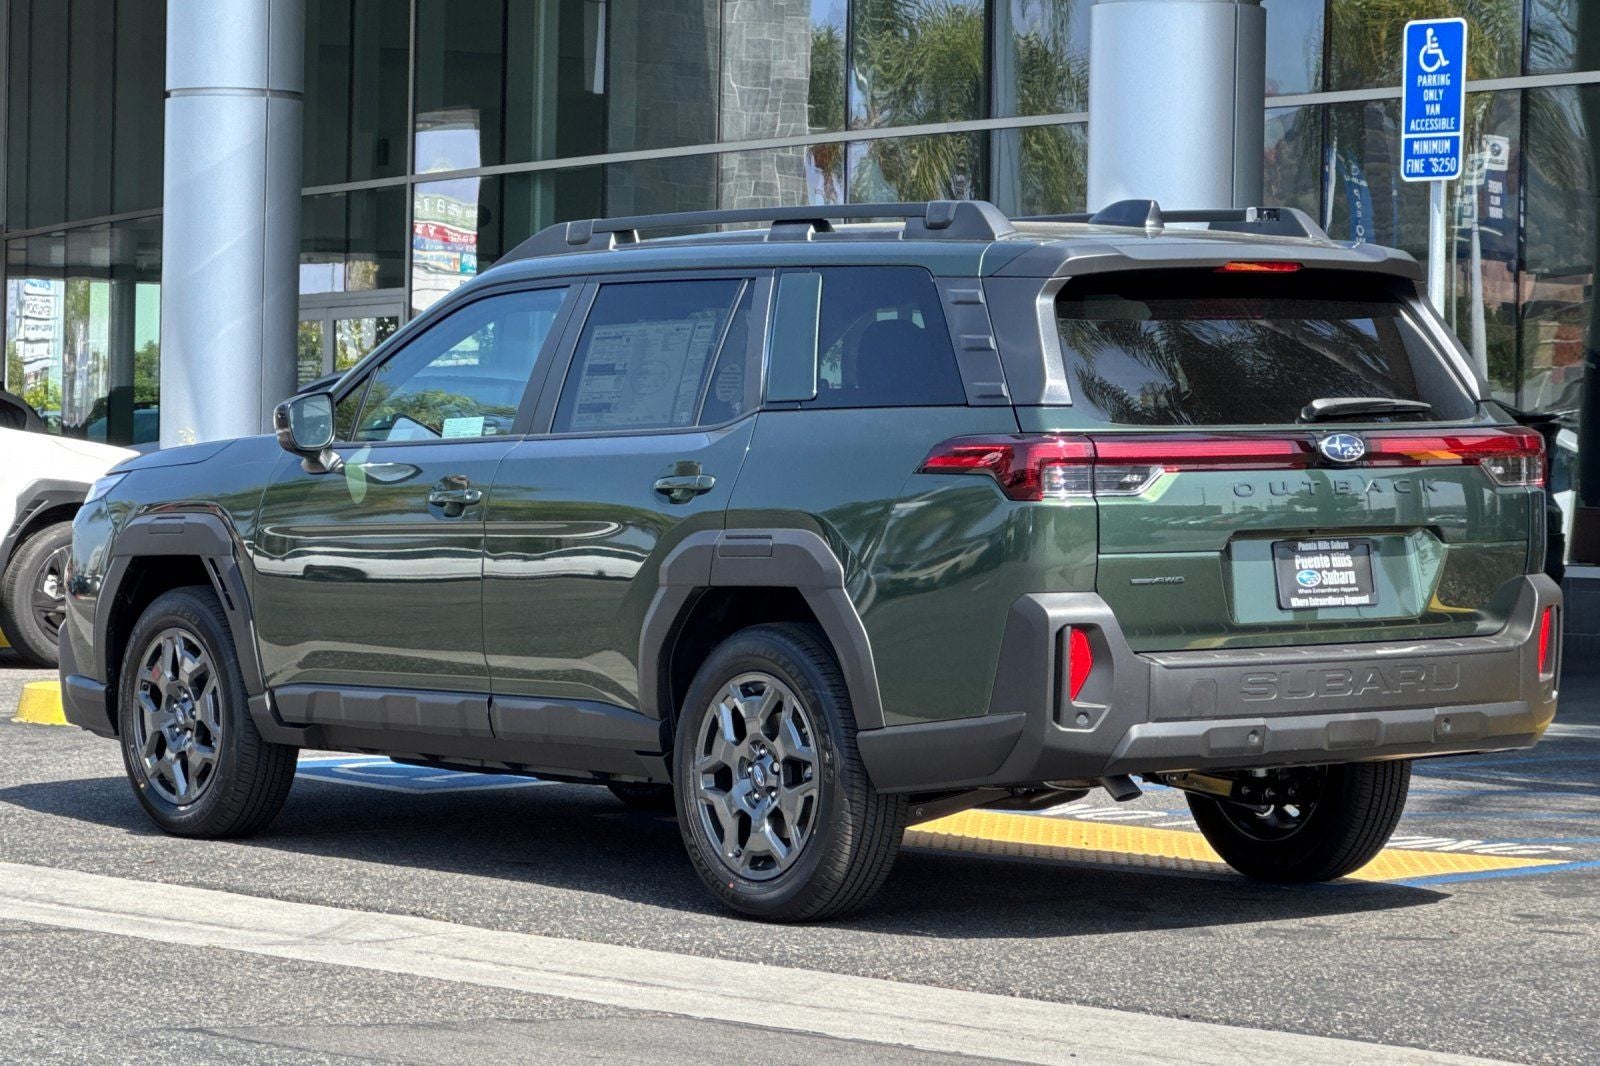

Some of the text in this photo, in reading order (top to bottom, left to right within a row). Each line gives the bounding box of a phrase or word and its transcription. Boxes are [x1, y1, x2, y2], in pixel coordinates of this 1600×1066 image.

[1417, 73, 1451, 87] PARKING
[1423, 88, 1444, 102] ONLY
[1425, 103, 1441, 116] VAN
[1409, 117, 1455, 132] ACCESSIBLE
[1413, 139, 1451, 155] MINIMUM
[1406, 157, 1457, 174] FINE $250
[1233, 479, 1438, 498] OUTBACK
[1297, 540, 1349, 551] Puente Hills Subaru
[1295, 552, 1353, 570] Puente Hills
[1321, 569, 1356, 585] Subaru
[1290, 597, 1309, 607] Where
[1309, 596, 1344, 606] Extraordinary
[1240, 662, 1460, 701] SUBARU
